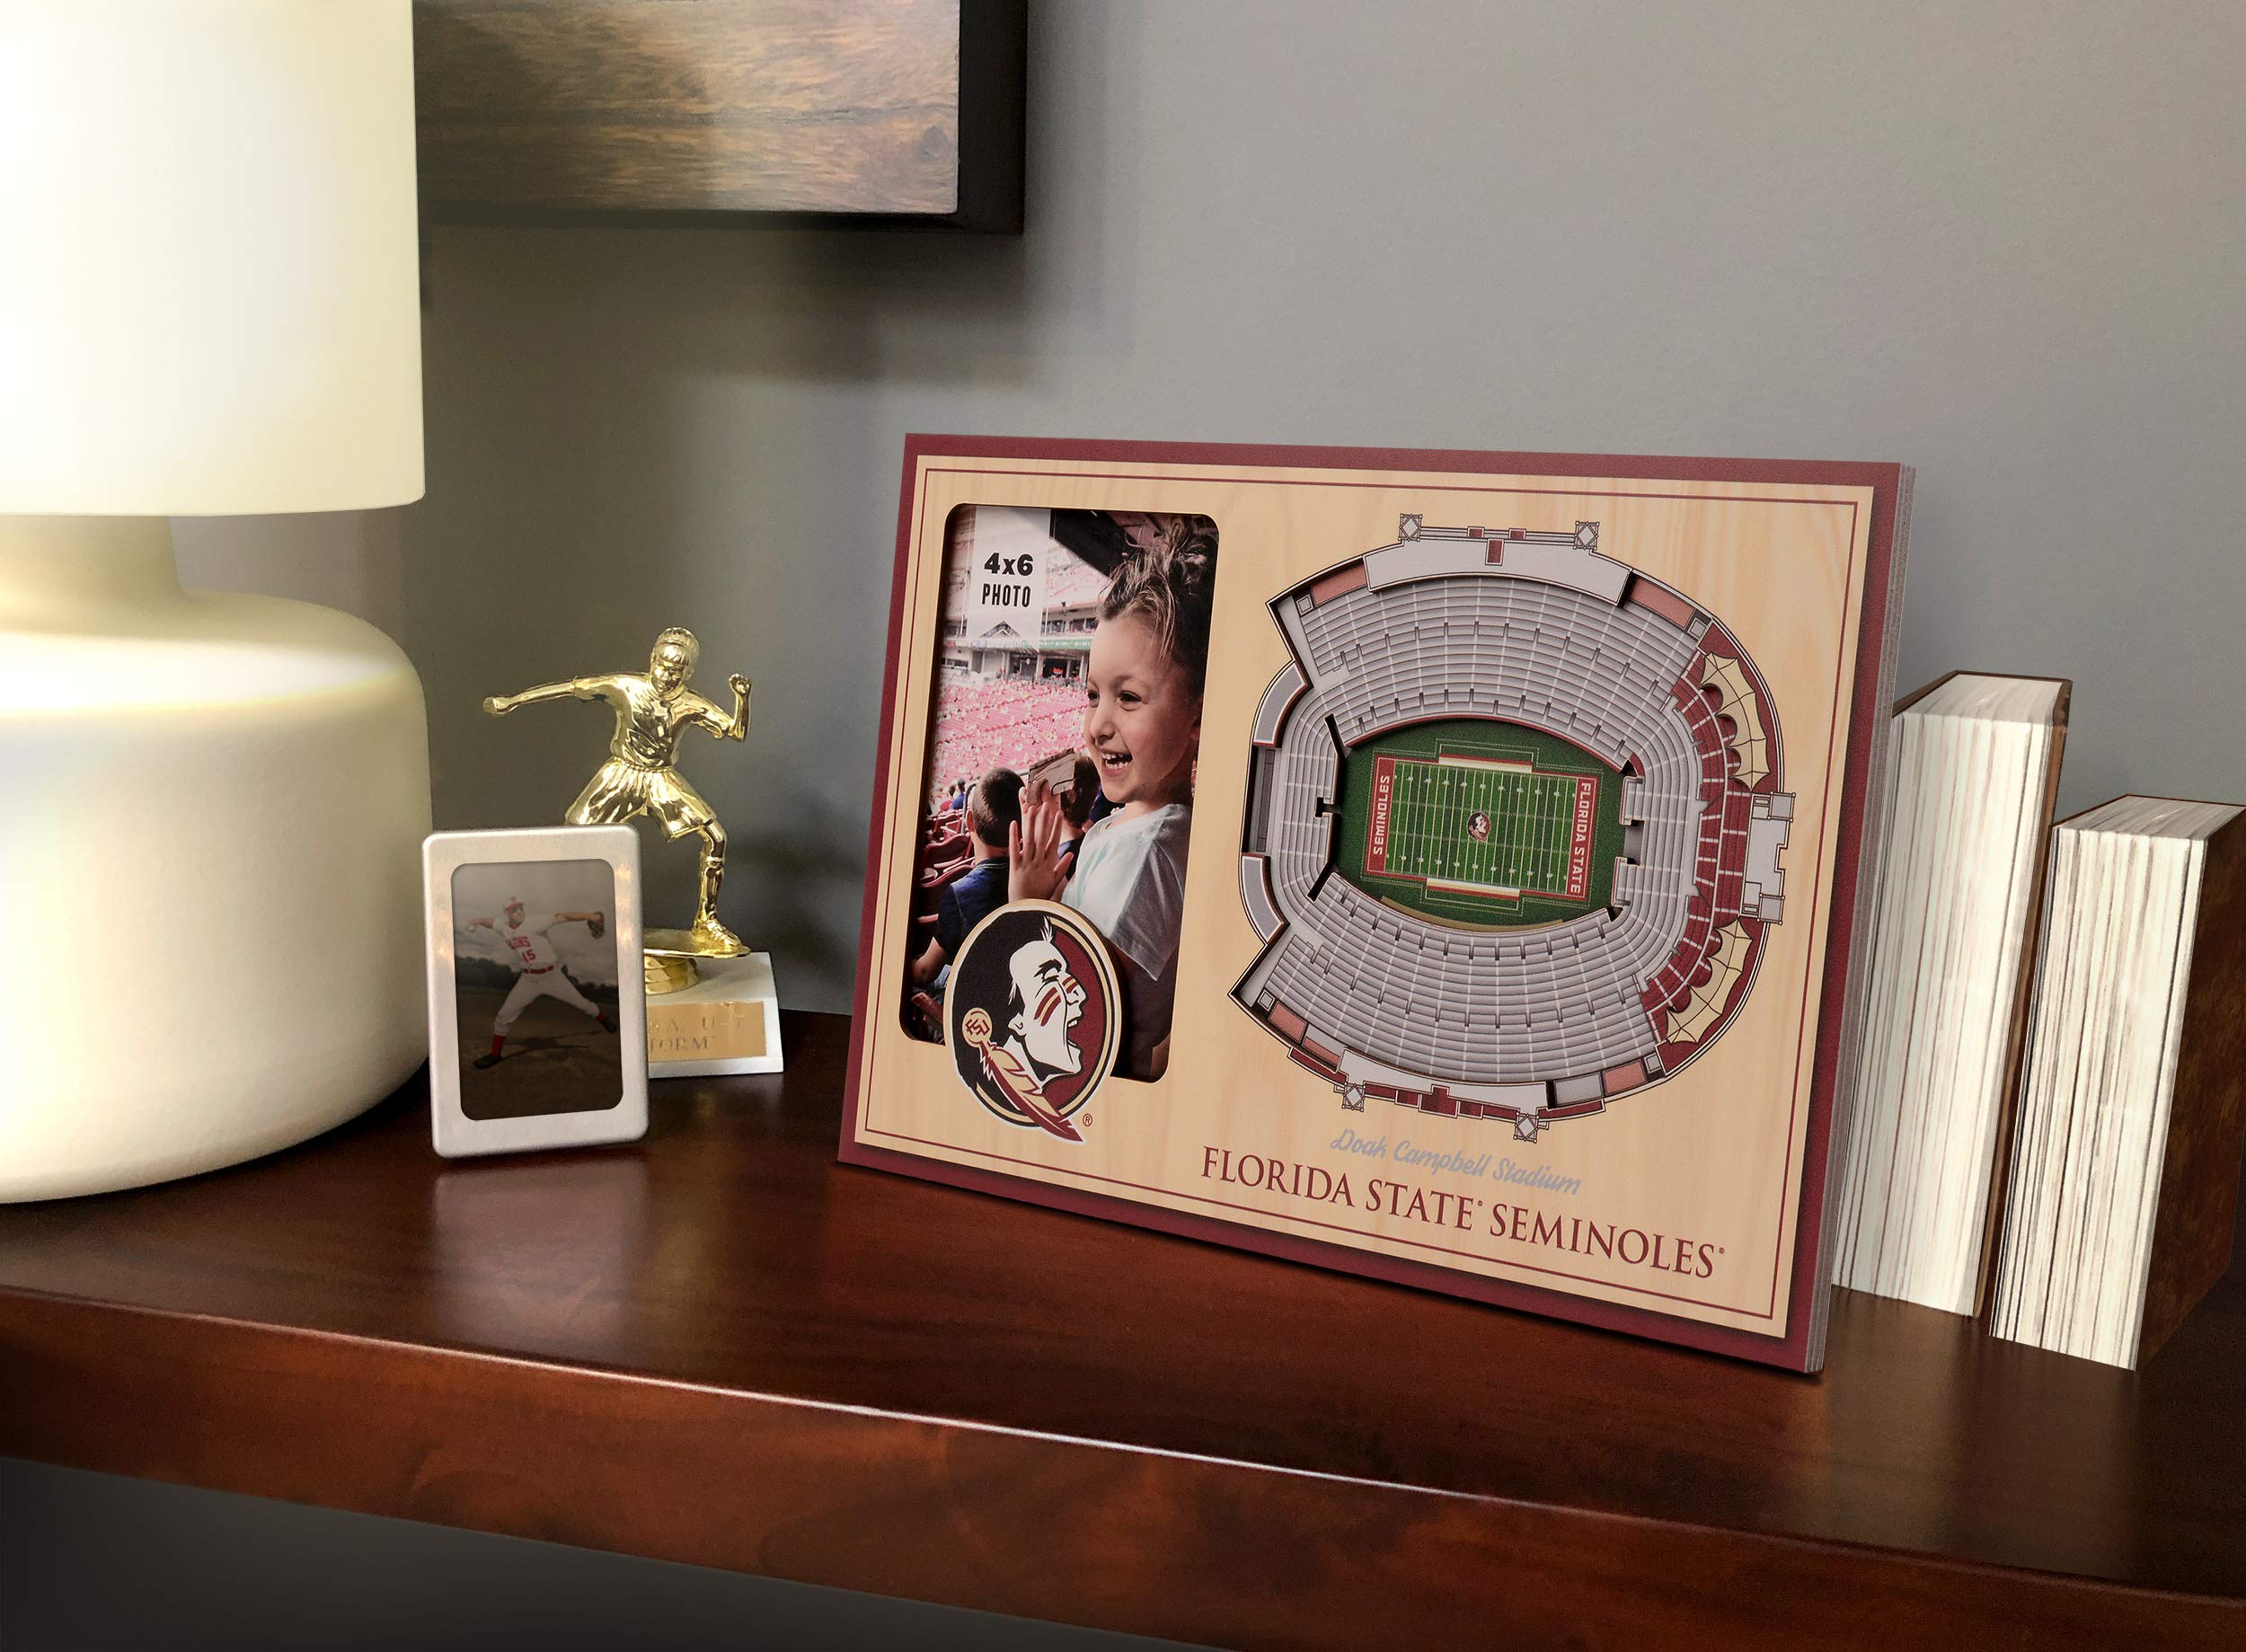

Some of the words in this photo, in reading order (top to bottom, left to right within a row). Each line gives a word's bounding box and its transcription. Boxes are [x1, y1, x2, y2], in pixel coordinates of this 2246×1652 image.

[983, 552, 1035, 577] 4x6
[981, 583, 1031, 608] PHOTO
[1373, 775, 1390, 855] SEMINOLES
[1575, 782, 1591, 843] FLORIDA
[1570, 846, 1585, 894] STATE
[522, 949, 536, 964] 15
[965, 1018, 991, 1036] FSU
[1200, 1145, 1356, 1207] FLORIDA
[1330, 1128, 1386, 1158] Doak
[1393, 1138, 1490, 1178] Campbell
[1493, 1157, 1582, 1197] Stadium
